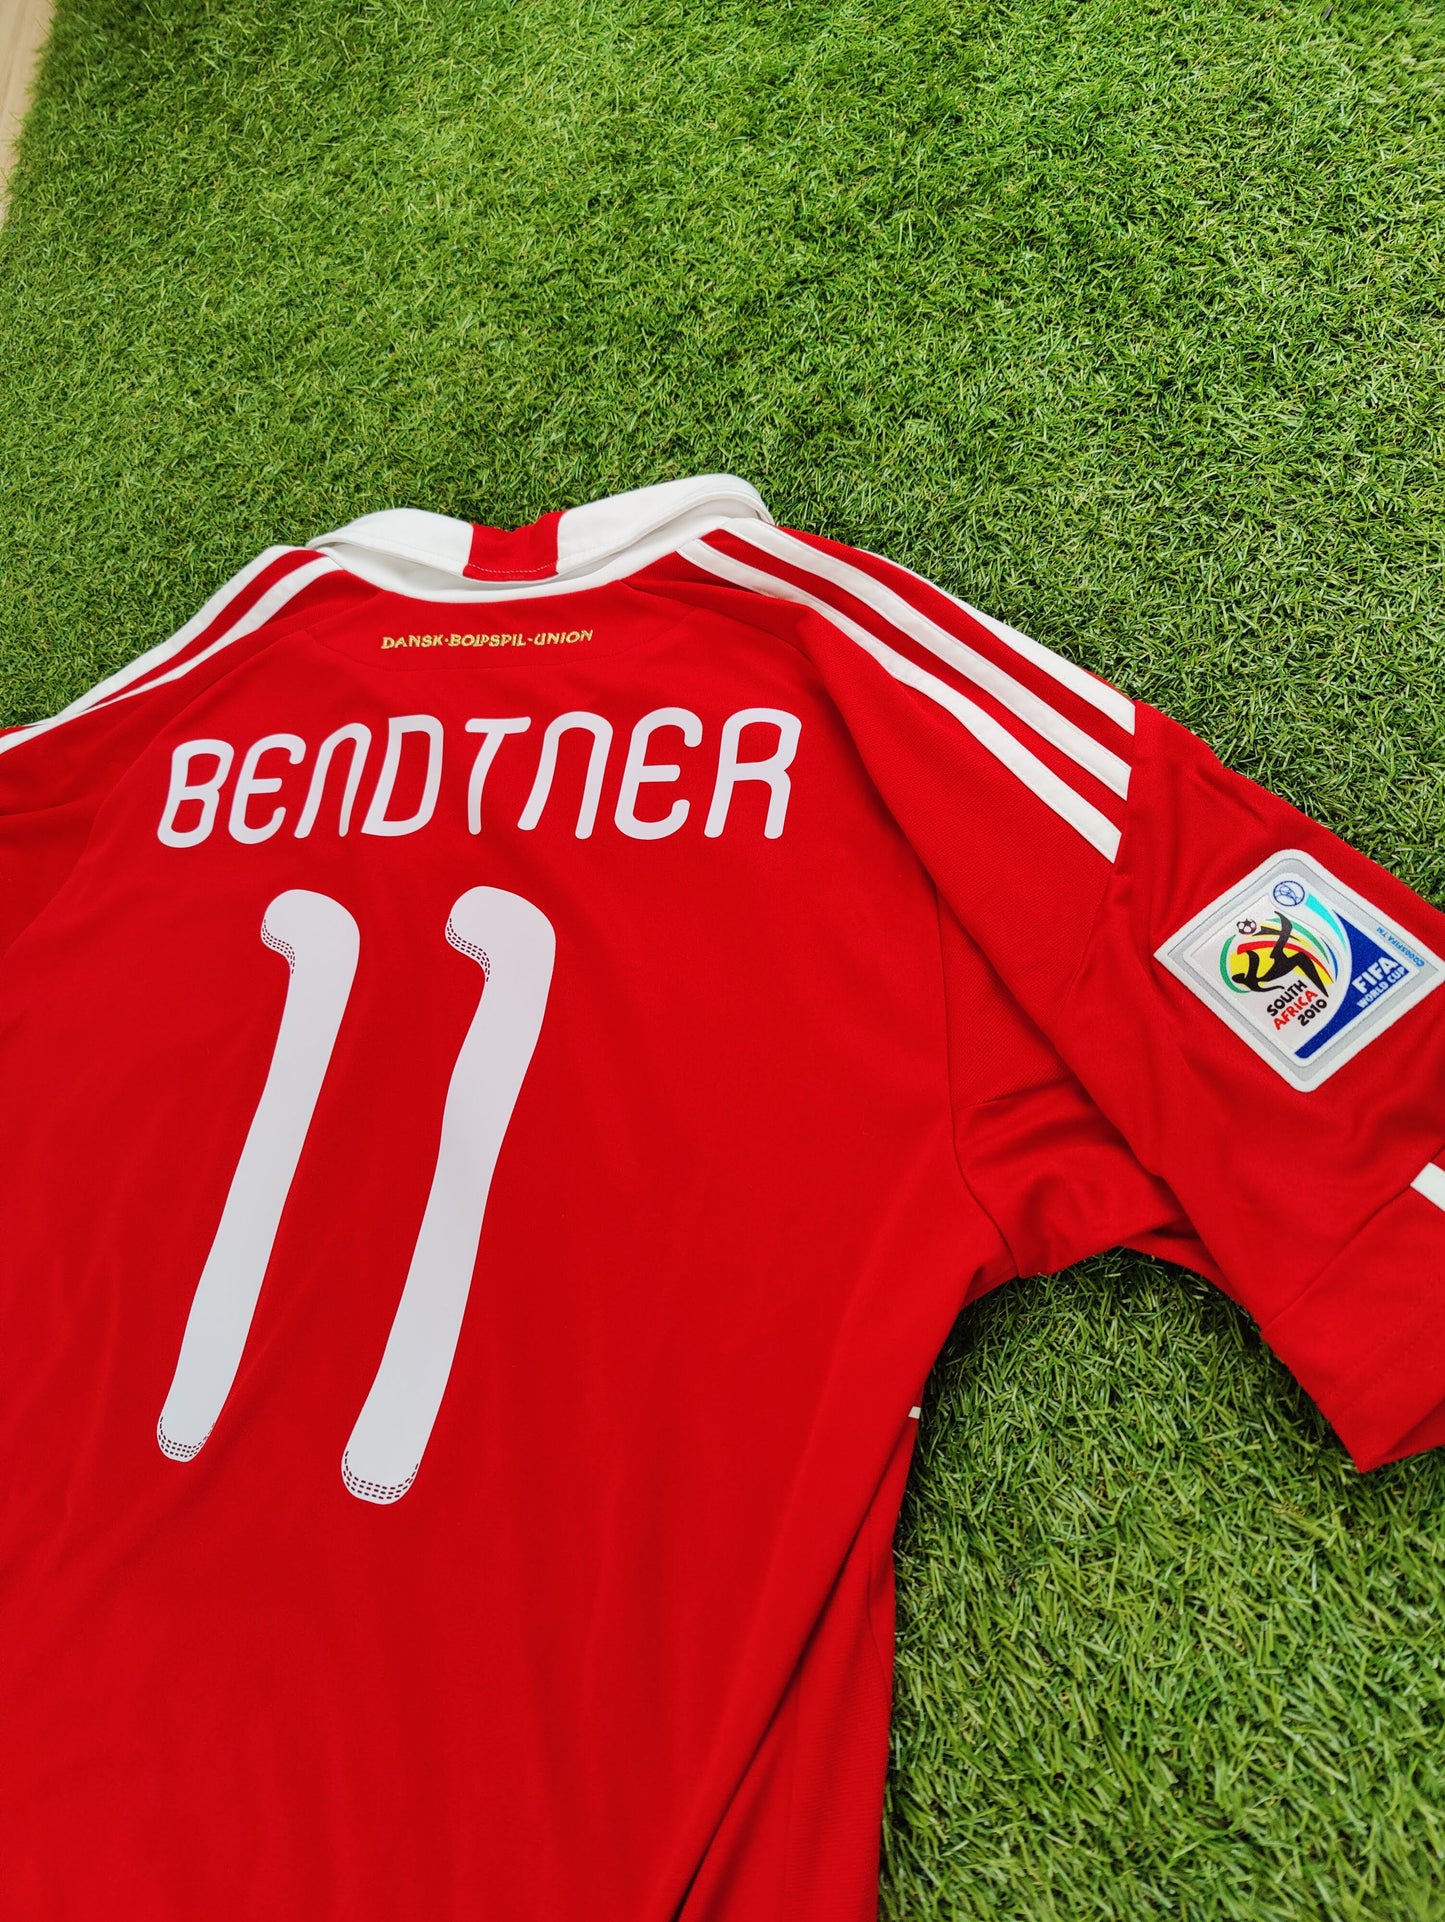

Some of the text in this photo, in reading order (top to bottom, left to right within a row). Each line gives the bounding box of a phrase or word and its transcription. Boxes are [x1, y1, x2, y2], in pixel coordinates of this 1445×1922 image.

[157, 707, 802, 848] BENDTNER
[1351, 957, 1399, 995] FIFA
[1356, 966, 1406, 1009] WORLD CUP
[1266, 979, 1308, 1017] SOUTH
[1273, 990, 1318, 1031] AFRICA
[1297, 999, 1328, 1027] 2010
[156, 886, 556, 1505] 11
